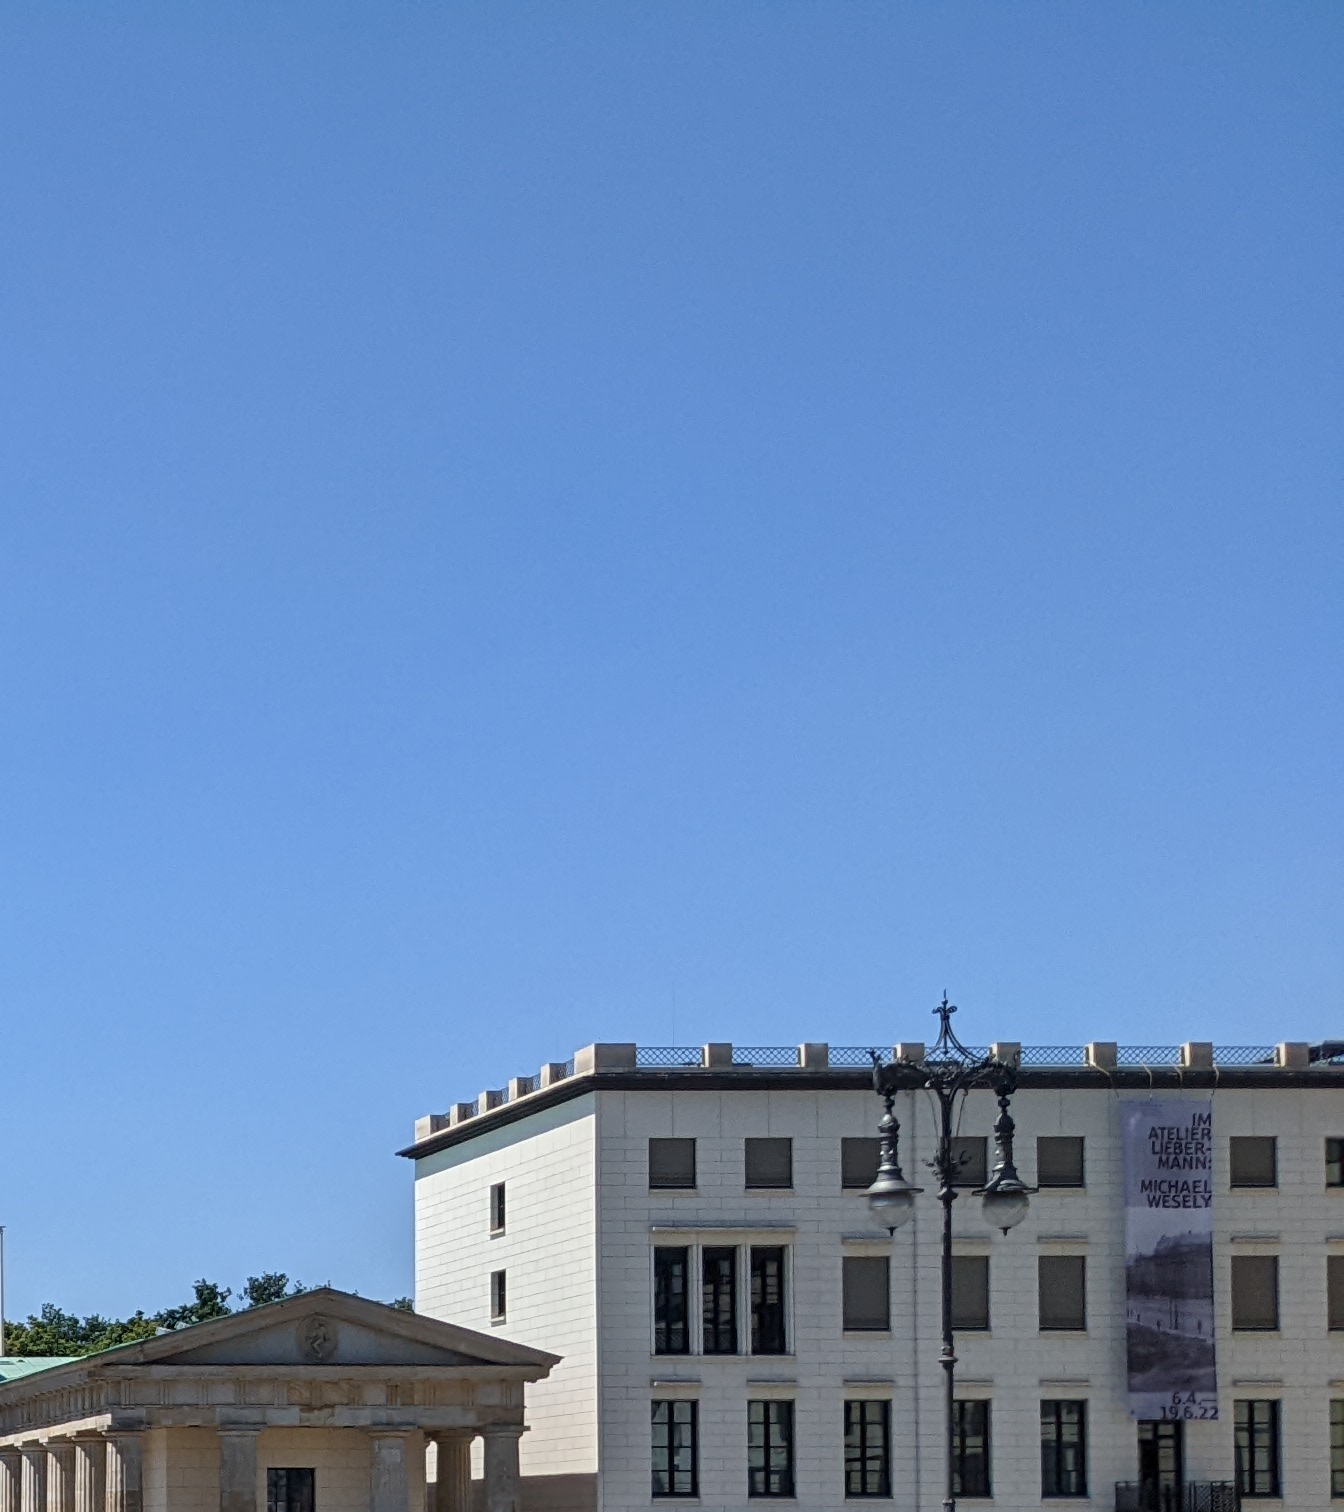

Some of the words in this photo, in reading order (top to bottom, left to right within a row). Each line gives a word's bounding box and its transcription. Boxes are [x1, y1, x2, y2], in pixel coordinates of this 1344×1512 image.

[1192, 1112, 1212, 1128] IM
[1148, 1126, 1212, 1142] ATELIER
[1151, 1141, 1212, 1156] LIEBER-
[1157, 1155, 1212, 1170] MANN:
[1140, 1179, 1212, 1194] MICHAEL
[1147, 1194, 1212, 1209] WESELY
